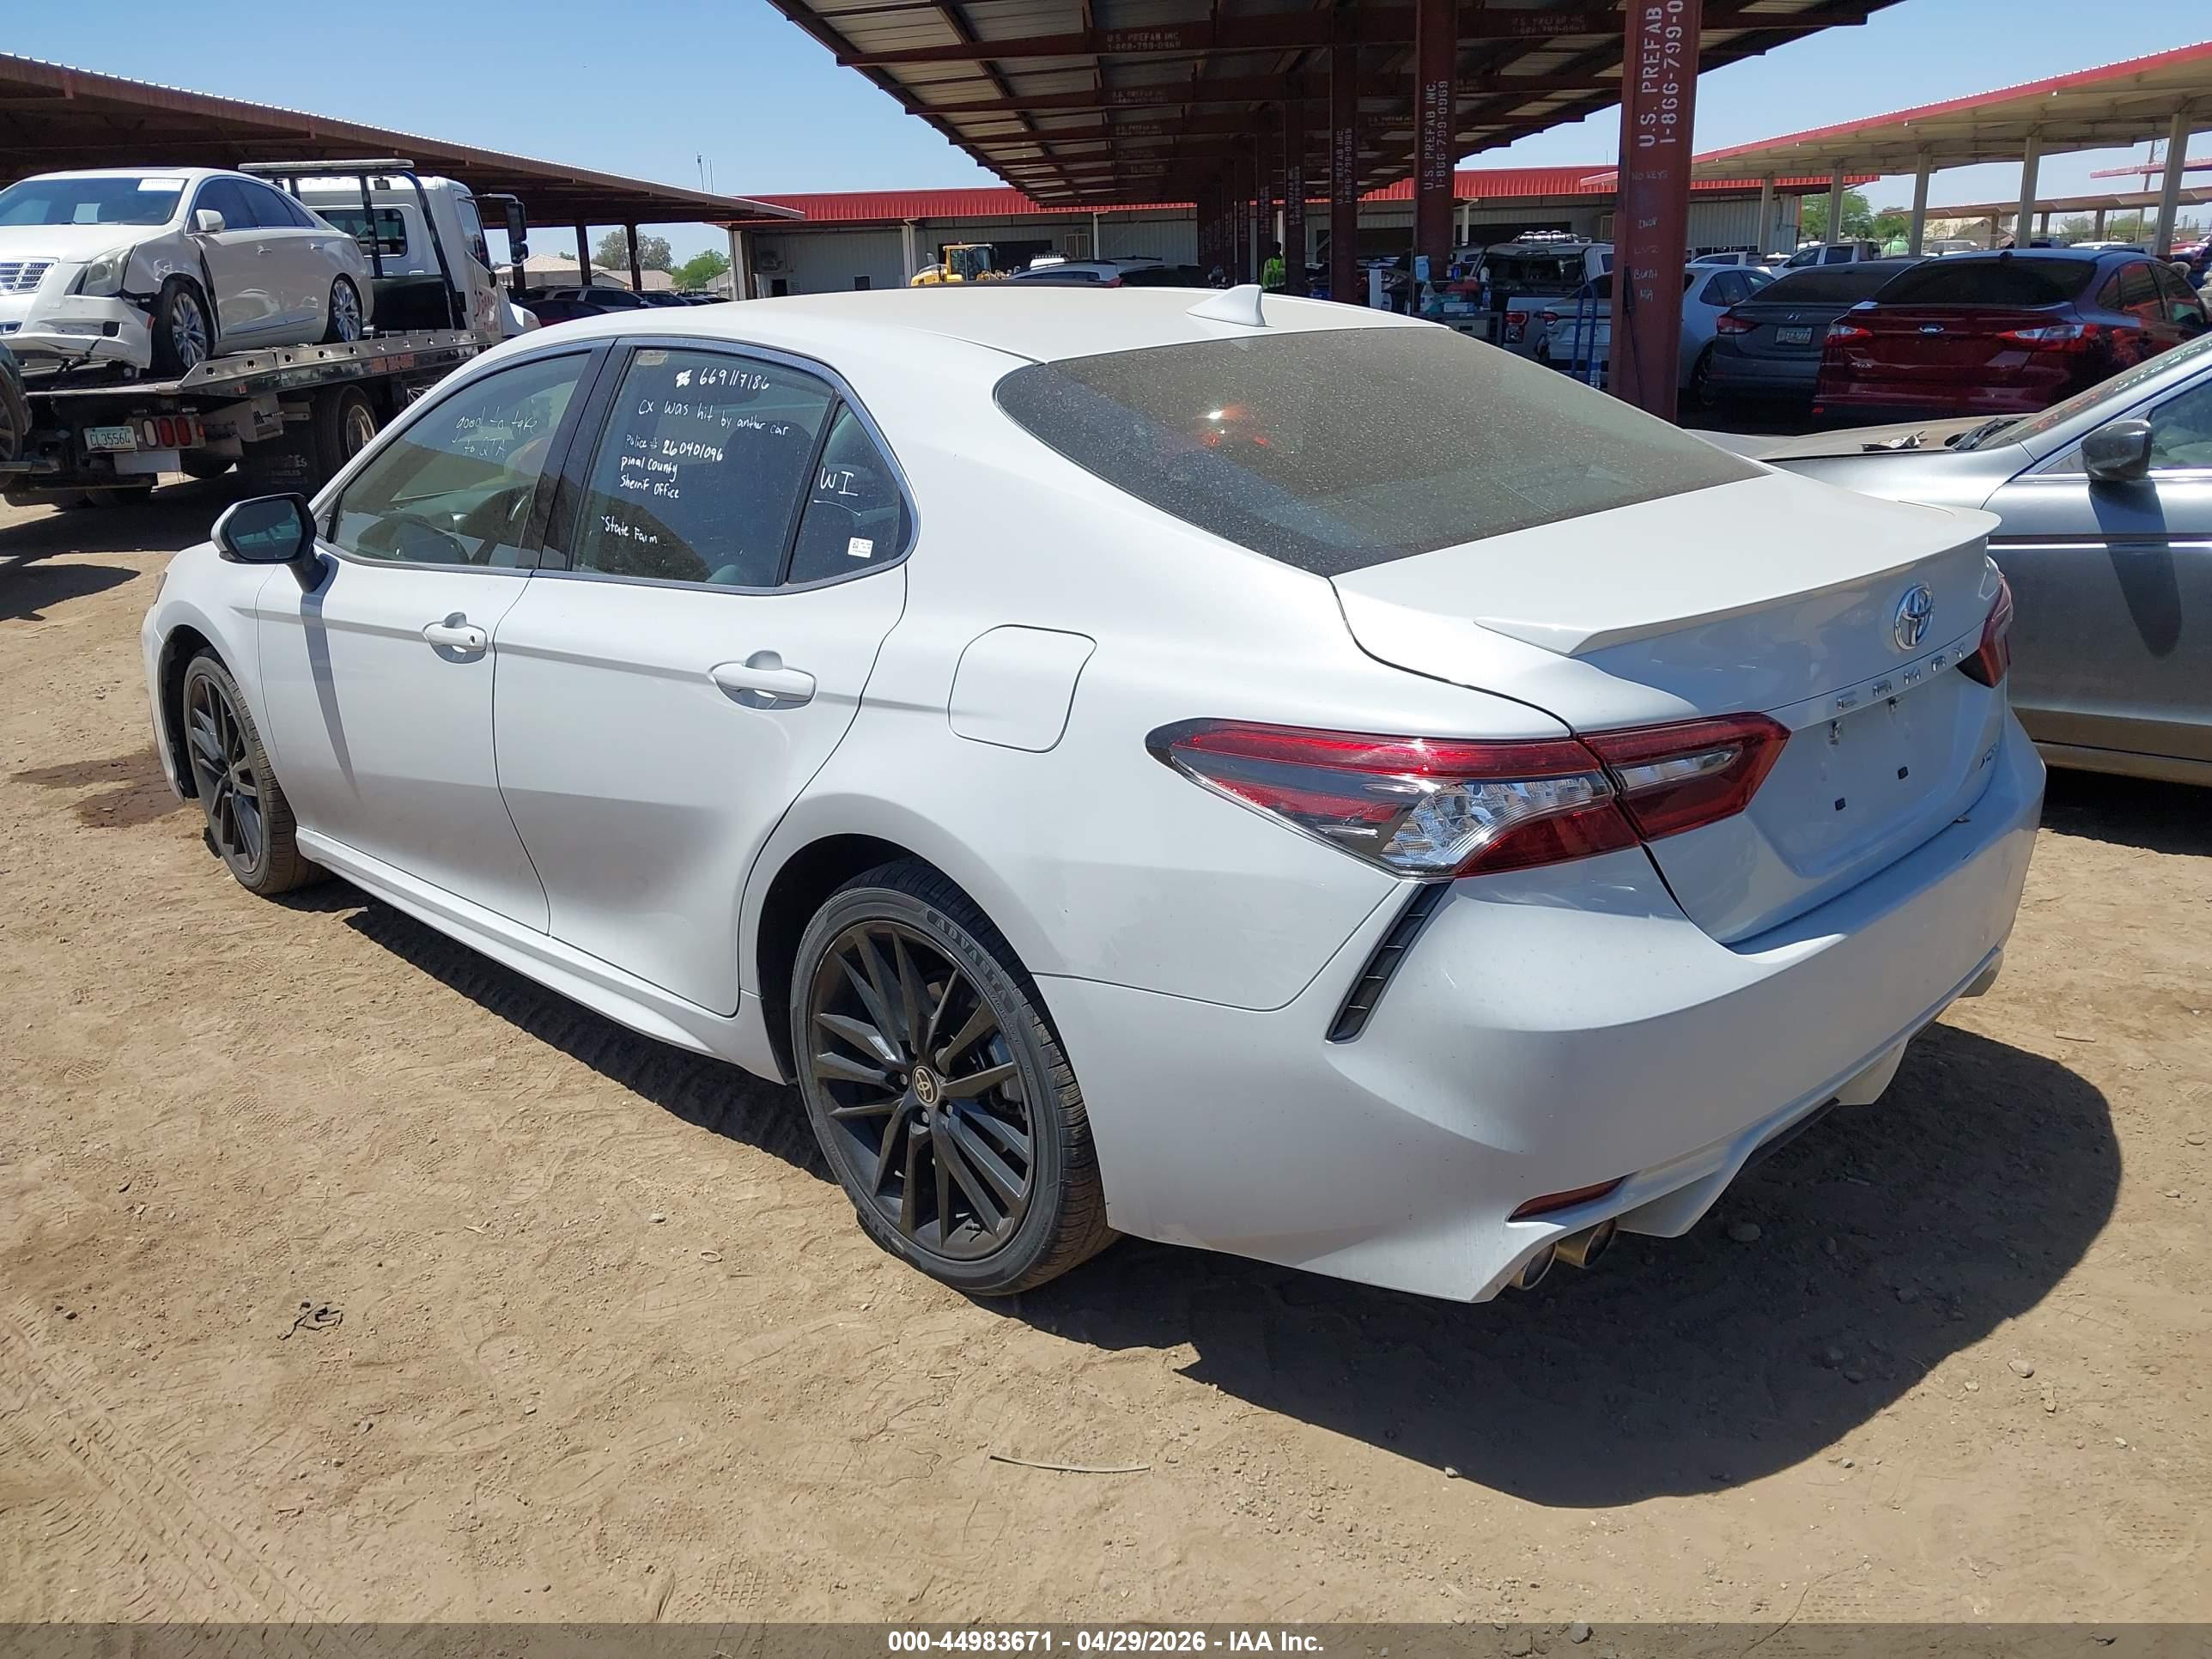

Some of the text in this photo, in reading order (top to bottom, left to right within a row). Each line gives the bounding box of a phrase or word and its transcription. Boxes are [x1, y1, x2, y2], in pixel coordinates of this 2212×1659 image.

[1638, 6, 1662, 147] U.S. PREFAB
[1424, 80, 1437, 190] U.S. PREFAB INC.
[452, 406, 486, 443] good
[697, 402, 714, 422] hit
[720, 410, 732, 428] by
[770, 424, 789, 436] car
[662, 439, 724, 462] 260401096
[604, 515, 658, 544] State Farm
